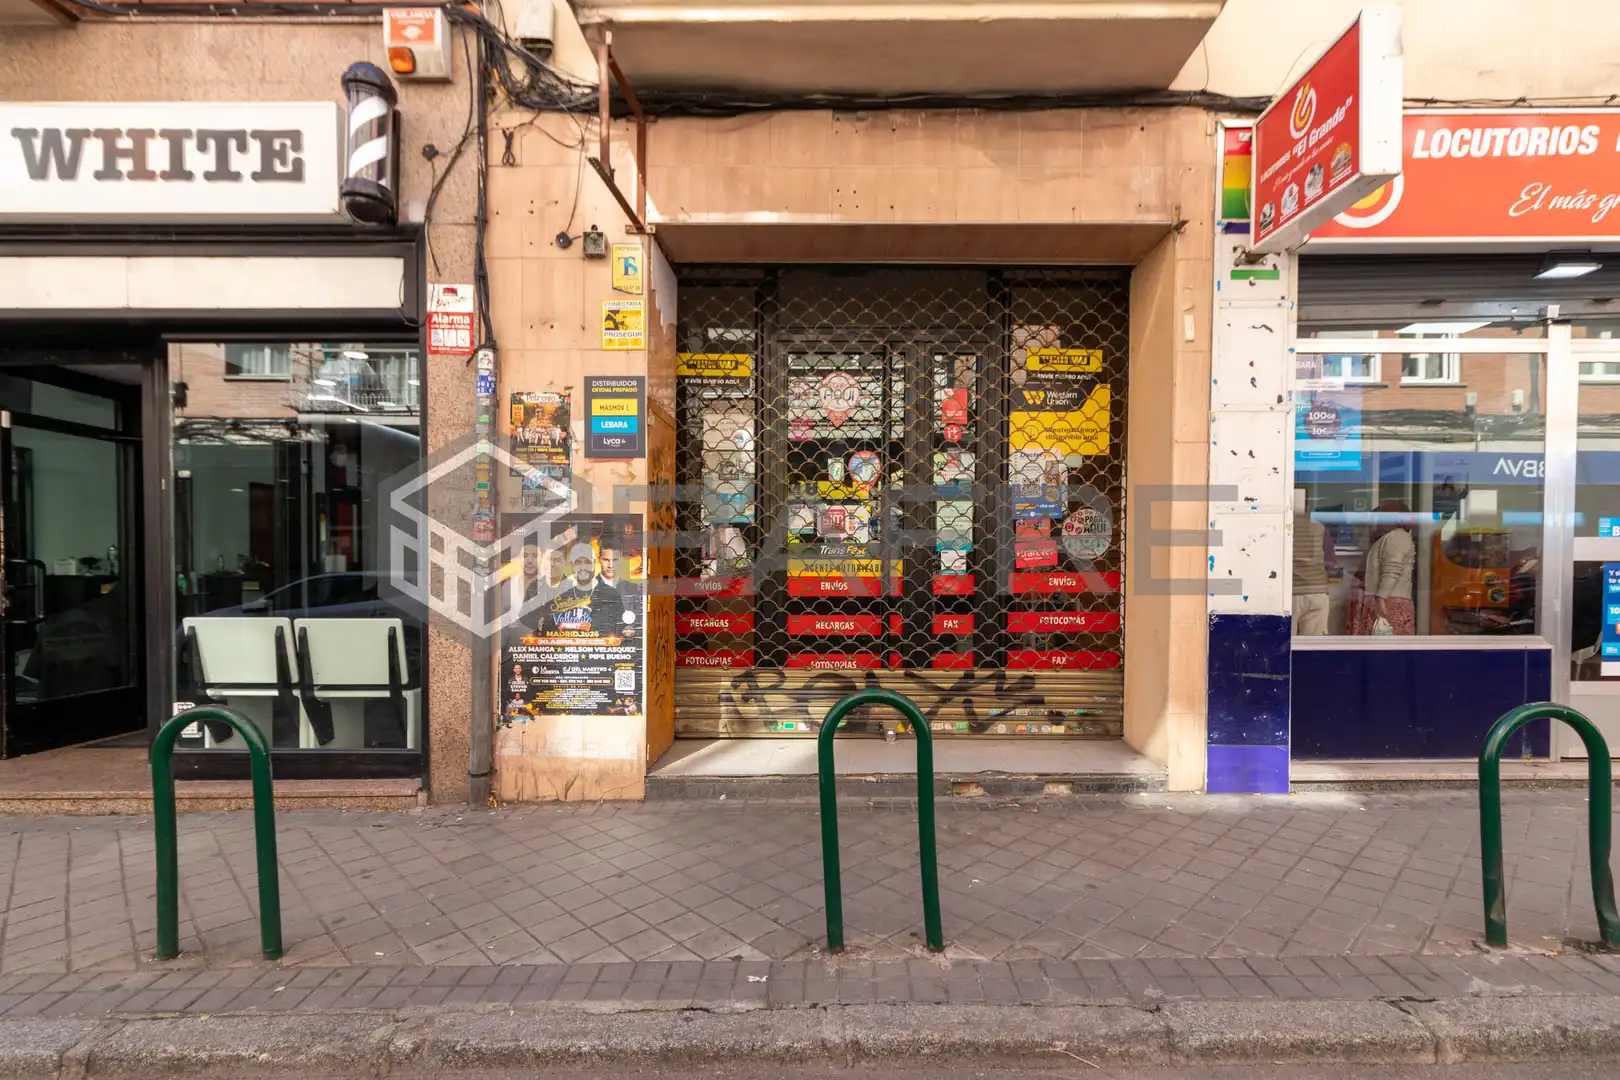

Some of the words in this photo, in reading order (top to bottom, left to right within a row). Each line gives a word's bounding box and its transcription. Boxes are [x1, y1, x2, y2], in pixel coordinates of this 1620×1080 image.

[1412, 125, 1600, 158] LOCUTORIOS
[11, 127, 305, 183] WHITE
[1508, 182, 1552, 217] El
[1548, 189, 1599, 211] más
[431, 313, 470, 324] Alarma
[1047, 391, 1077, 399] Western
[600, 420, 628, 429] LEBARA
[603, 437, 621, 445] Lyca
[834, 563, 884, 572] AUTORIZAD
[820, 580, 848, 590] ENVÍOS
[1049, 576, 1076, 586] ENVÍOS
[690, 618, 729, 627] RECARGAS
[943, 619, 959, 628] FAX
[1040, 616, 1086, 625] FOTOCOPIAS
[815, 621, 854, 630] RECARGAS
[685, 656, 732, 666] FOTOCOPIAS
[811, 660, 857, 669] FOTOCOPIAS
[1052, 656, 1067, 664] FAX
